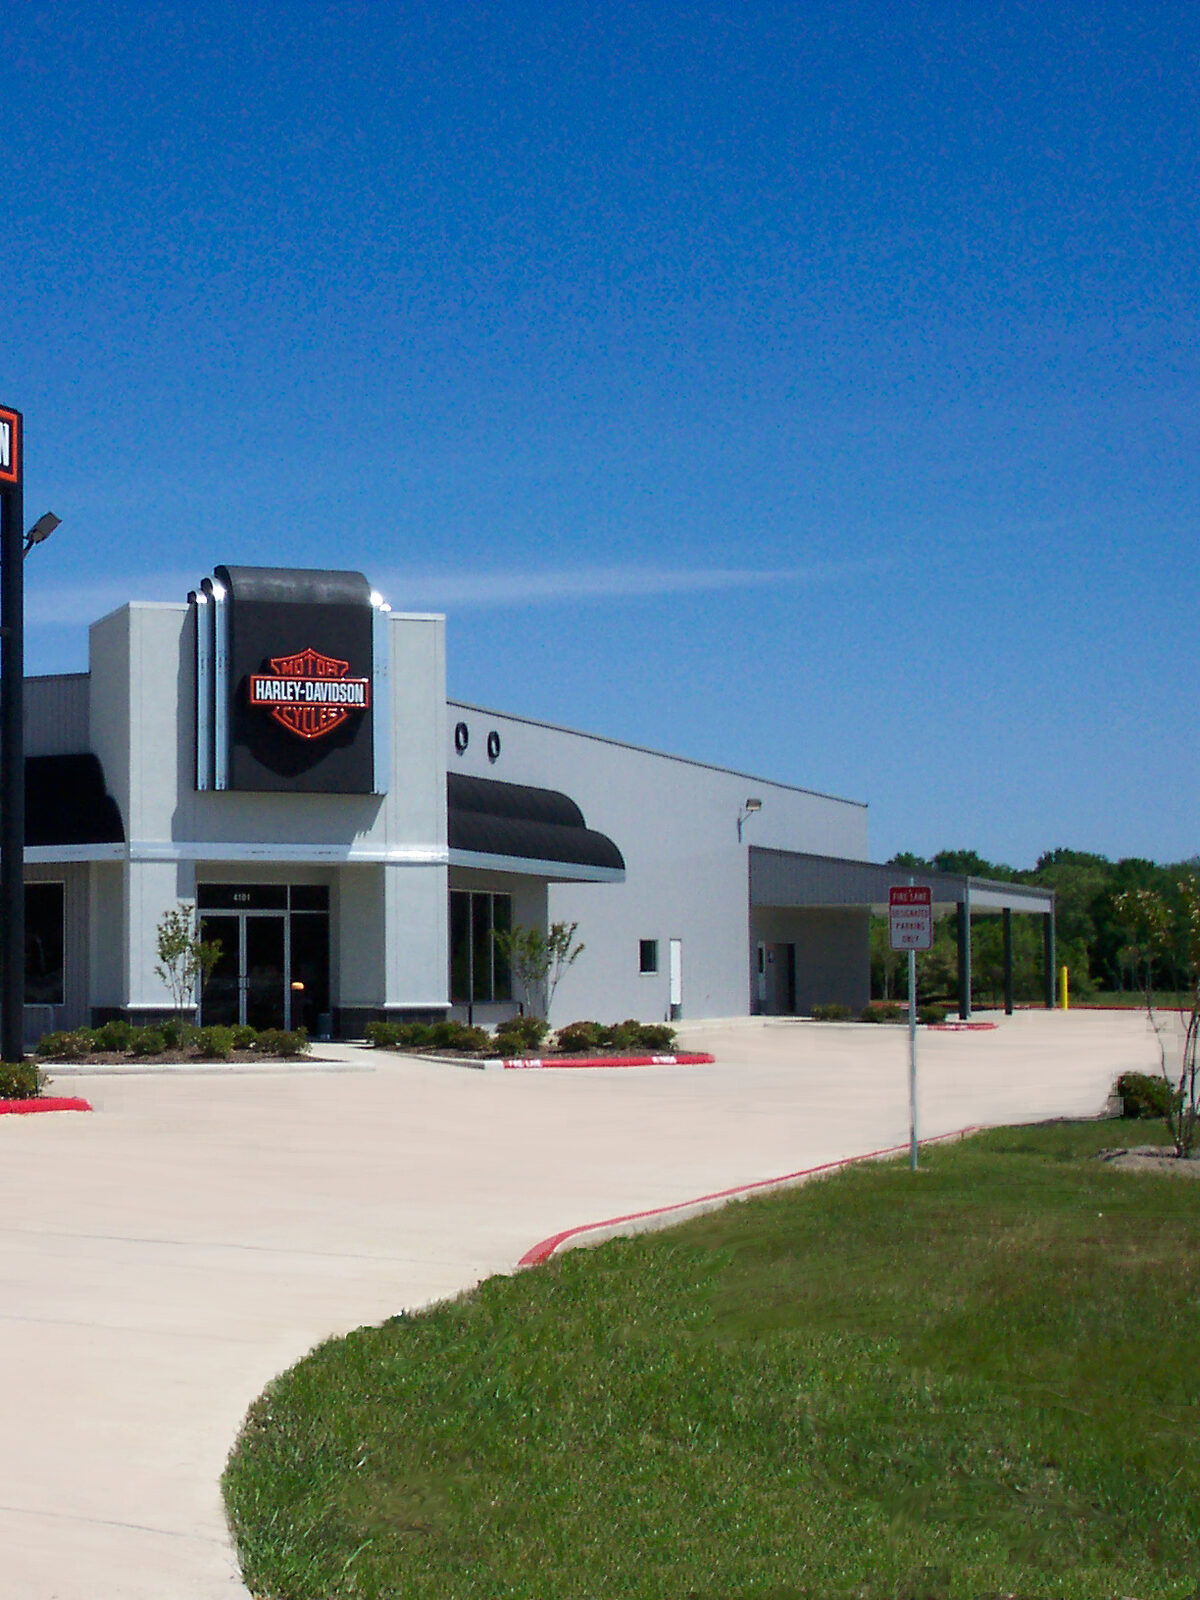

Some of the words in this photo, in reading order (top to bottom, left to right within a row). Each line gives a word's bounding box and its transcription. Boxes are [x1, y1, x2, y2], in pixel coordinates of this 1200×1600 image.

[281, 654, 338, 676] MOTOR
[255, 680, 364, 703] HARLEY-DAVIDSON
[282, 706, 338, 733] CYCLES
